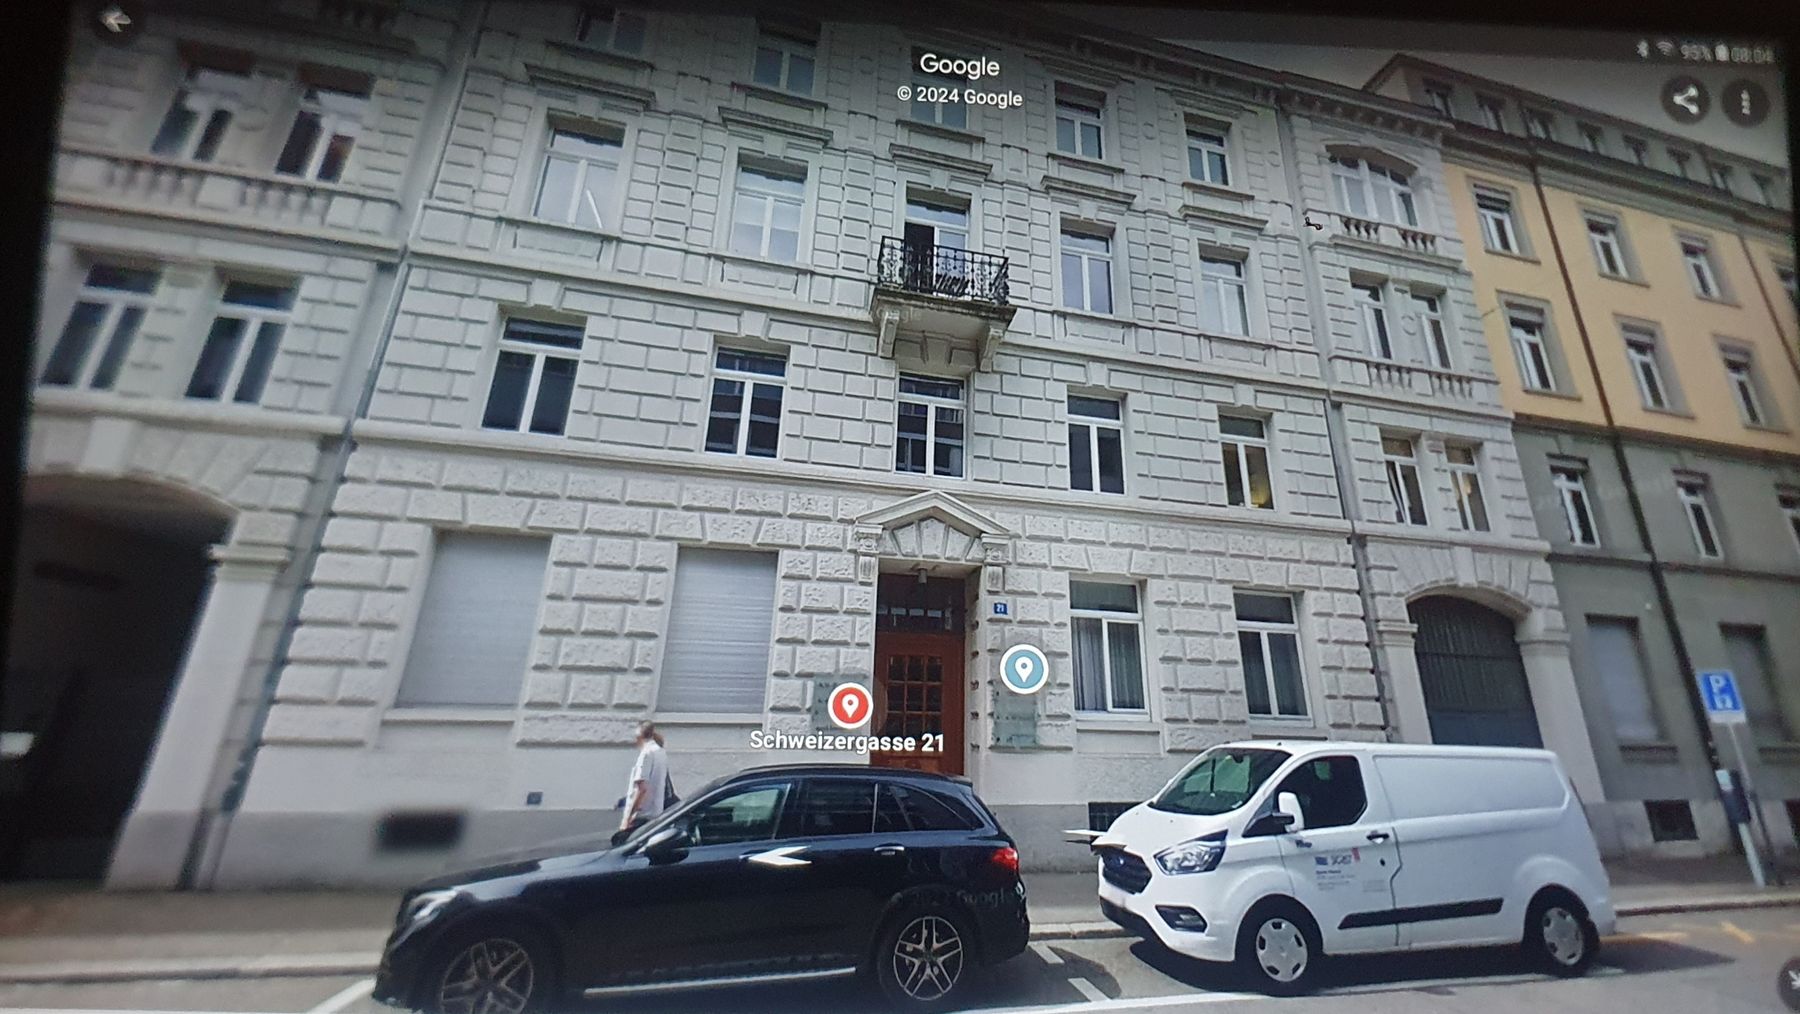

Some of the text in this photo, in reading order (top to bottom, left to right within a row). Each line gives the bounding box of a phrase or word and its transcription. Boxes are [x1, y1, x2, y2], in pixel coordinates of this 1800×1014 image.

[920, 54, 999, 79] Google
[897, 85, 1022, 108] © 2024 Google
[996, 603, 1005, 613] 21
[1709, 675, 1726, 694] P
[750, 731, 944, 754] Schweizergasse 21
